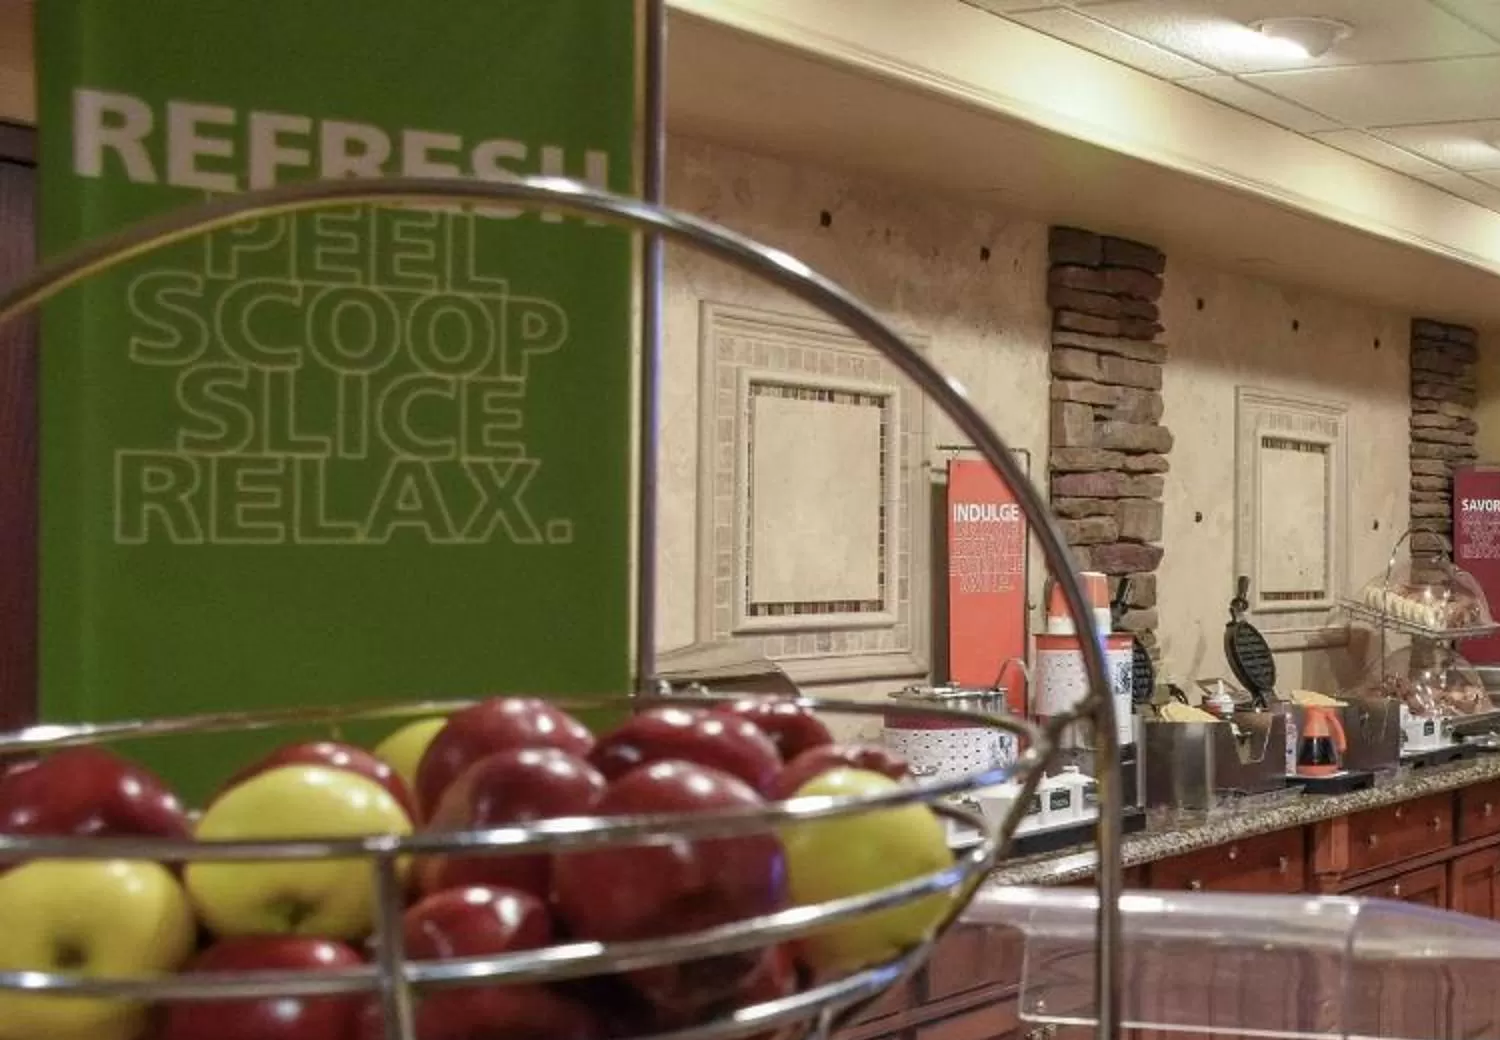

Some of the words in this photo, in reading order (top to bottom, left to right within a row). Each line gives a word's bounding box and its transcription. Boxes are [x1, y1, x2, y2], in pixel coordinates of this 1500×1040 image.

[204, 190, 509, 297] PEEL
[128, 271, 568, 380] SCOOP
[176, 362, 526, 461] SLICE
[114, 448, 574, 544] RELAX.
[953, 502, 1020, 522] INDULGE
